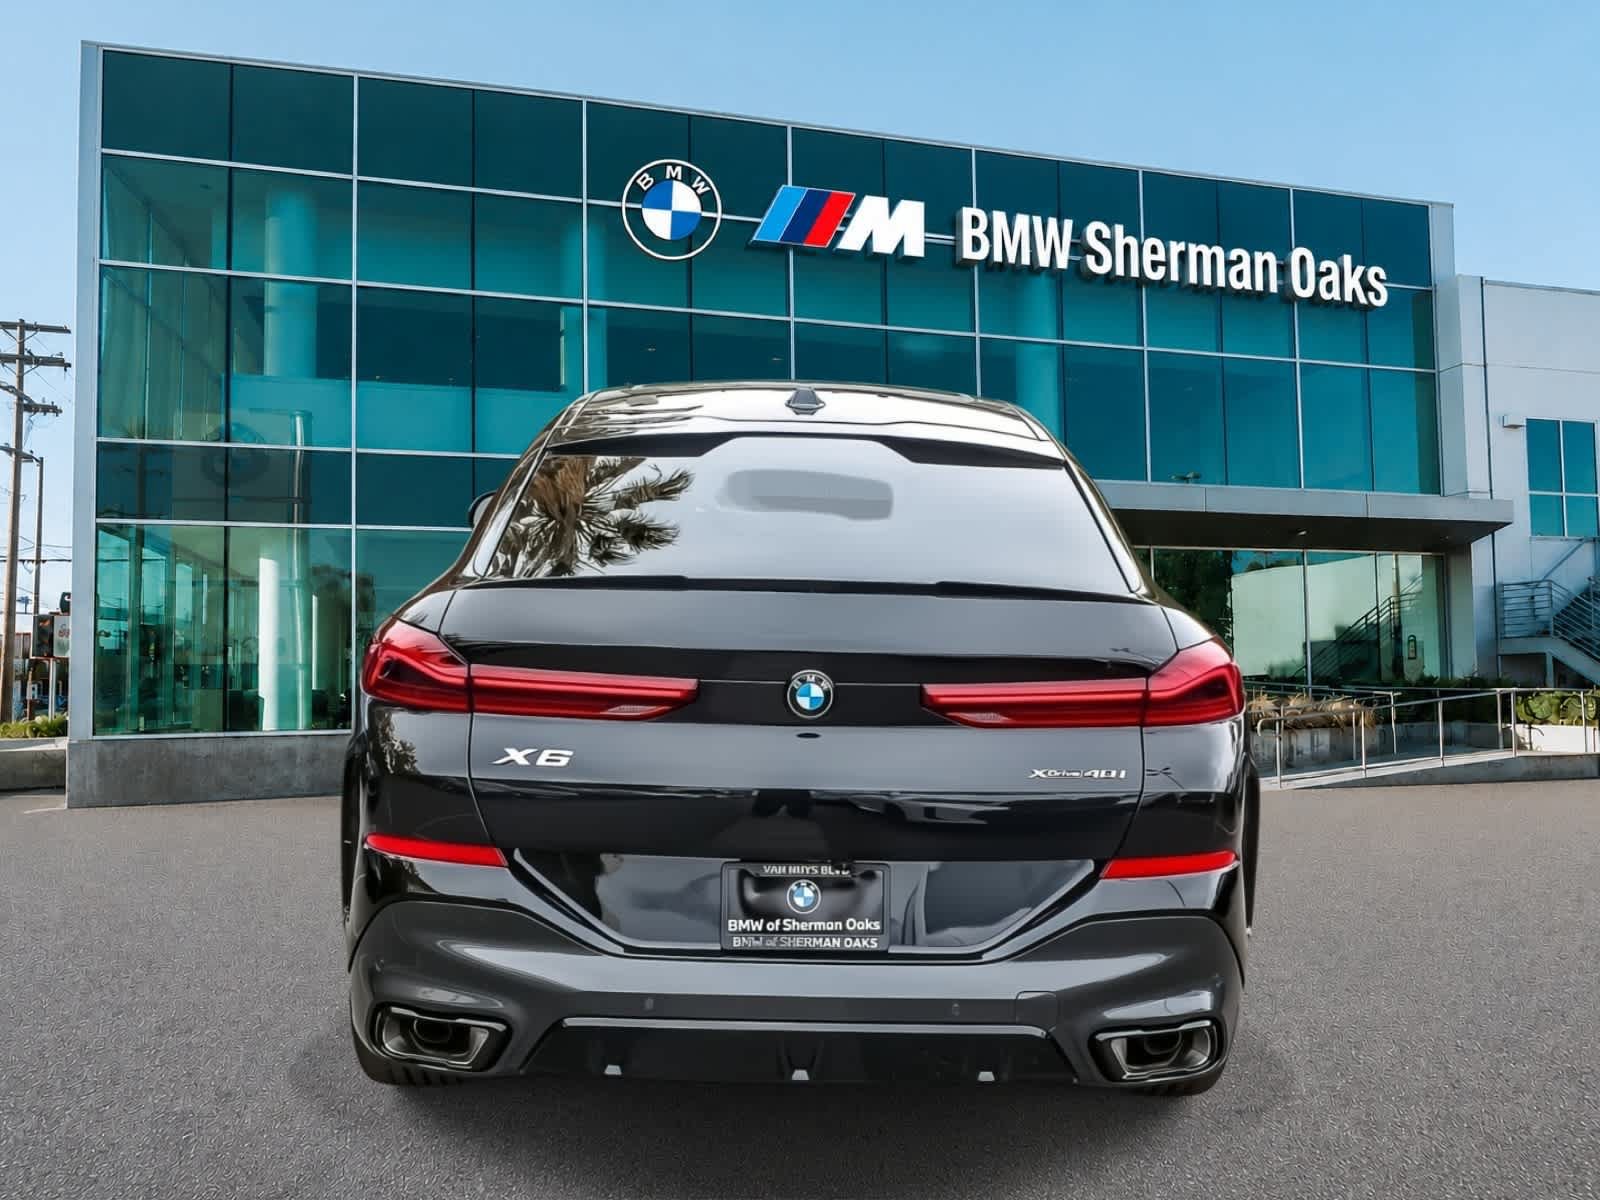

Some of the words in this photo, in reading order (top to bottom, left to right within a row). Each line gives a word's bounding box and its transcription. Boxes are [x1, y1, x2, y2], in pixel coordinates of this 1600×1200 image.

[636, 164, 712, 196] BMW
[836, 195, 925, 257] M
[959, 206, 1074, 270] BMW
[1083, 219, 1279, 294] Sherman
[1288, 246, 1389, 307] Oaks
[492, 747, 574, 767] X6
[763, 865, 786, 874] VAN
[788, 865, 819, 874] NUYS
[727, 919, 764, 932] BMW
[766, 919, 781, 931] of
[782, 919, 843, 931] Sherman
[846, 918, 881, 930] Oaks
[779, 937, 841, 948] SHERMAN
[844, 938, 878, 948] OAKS
